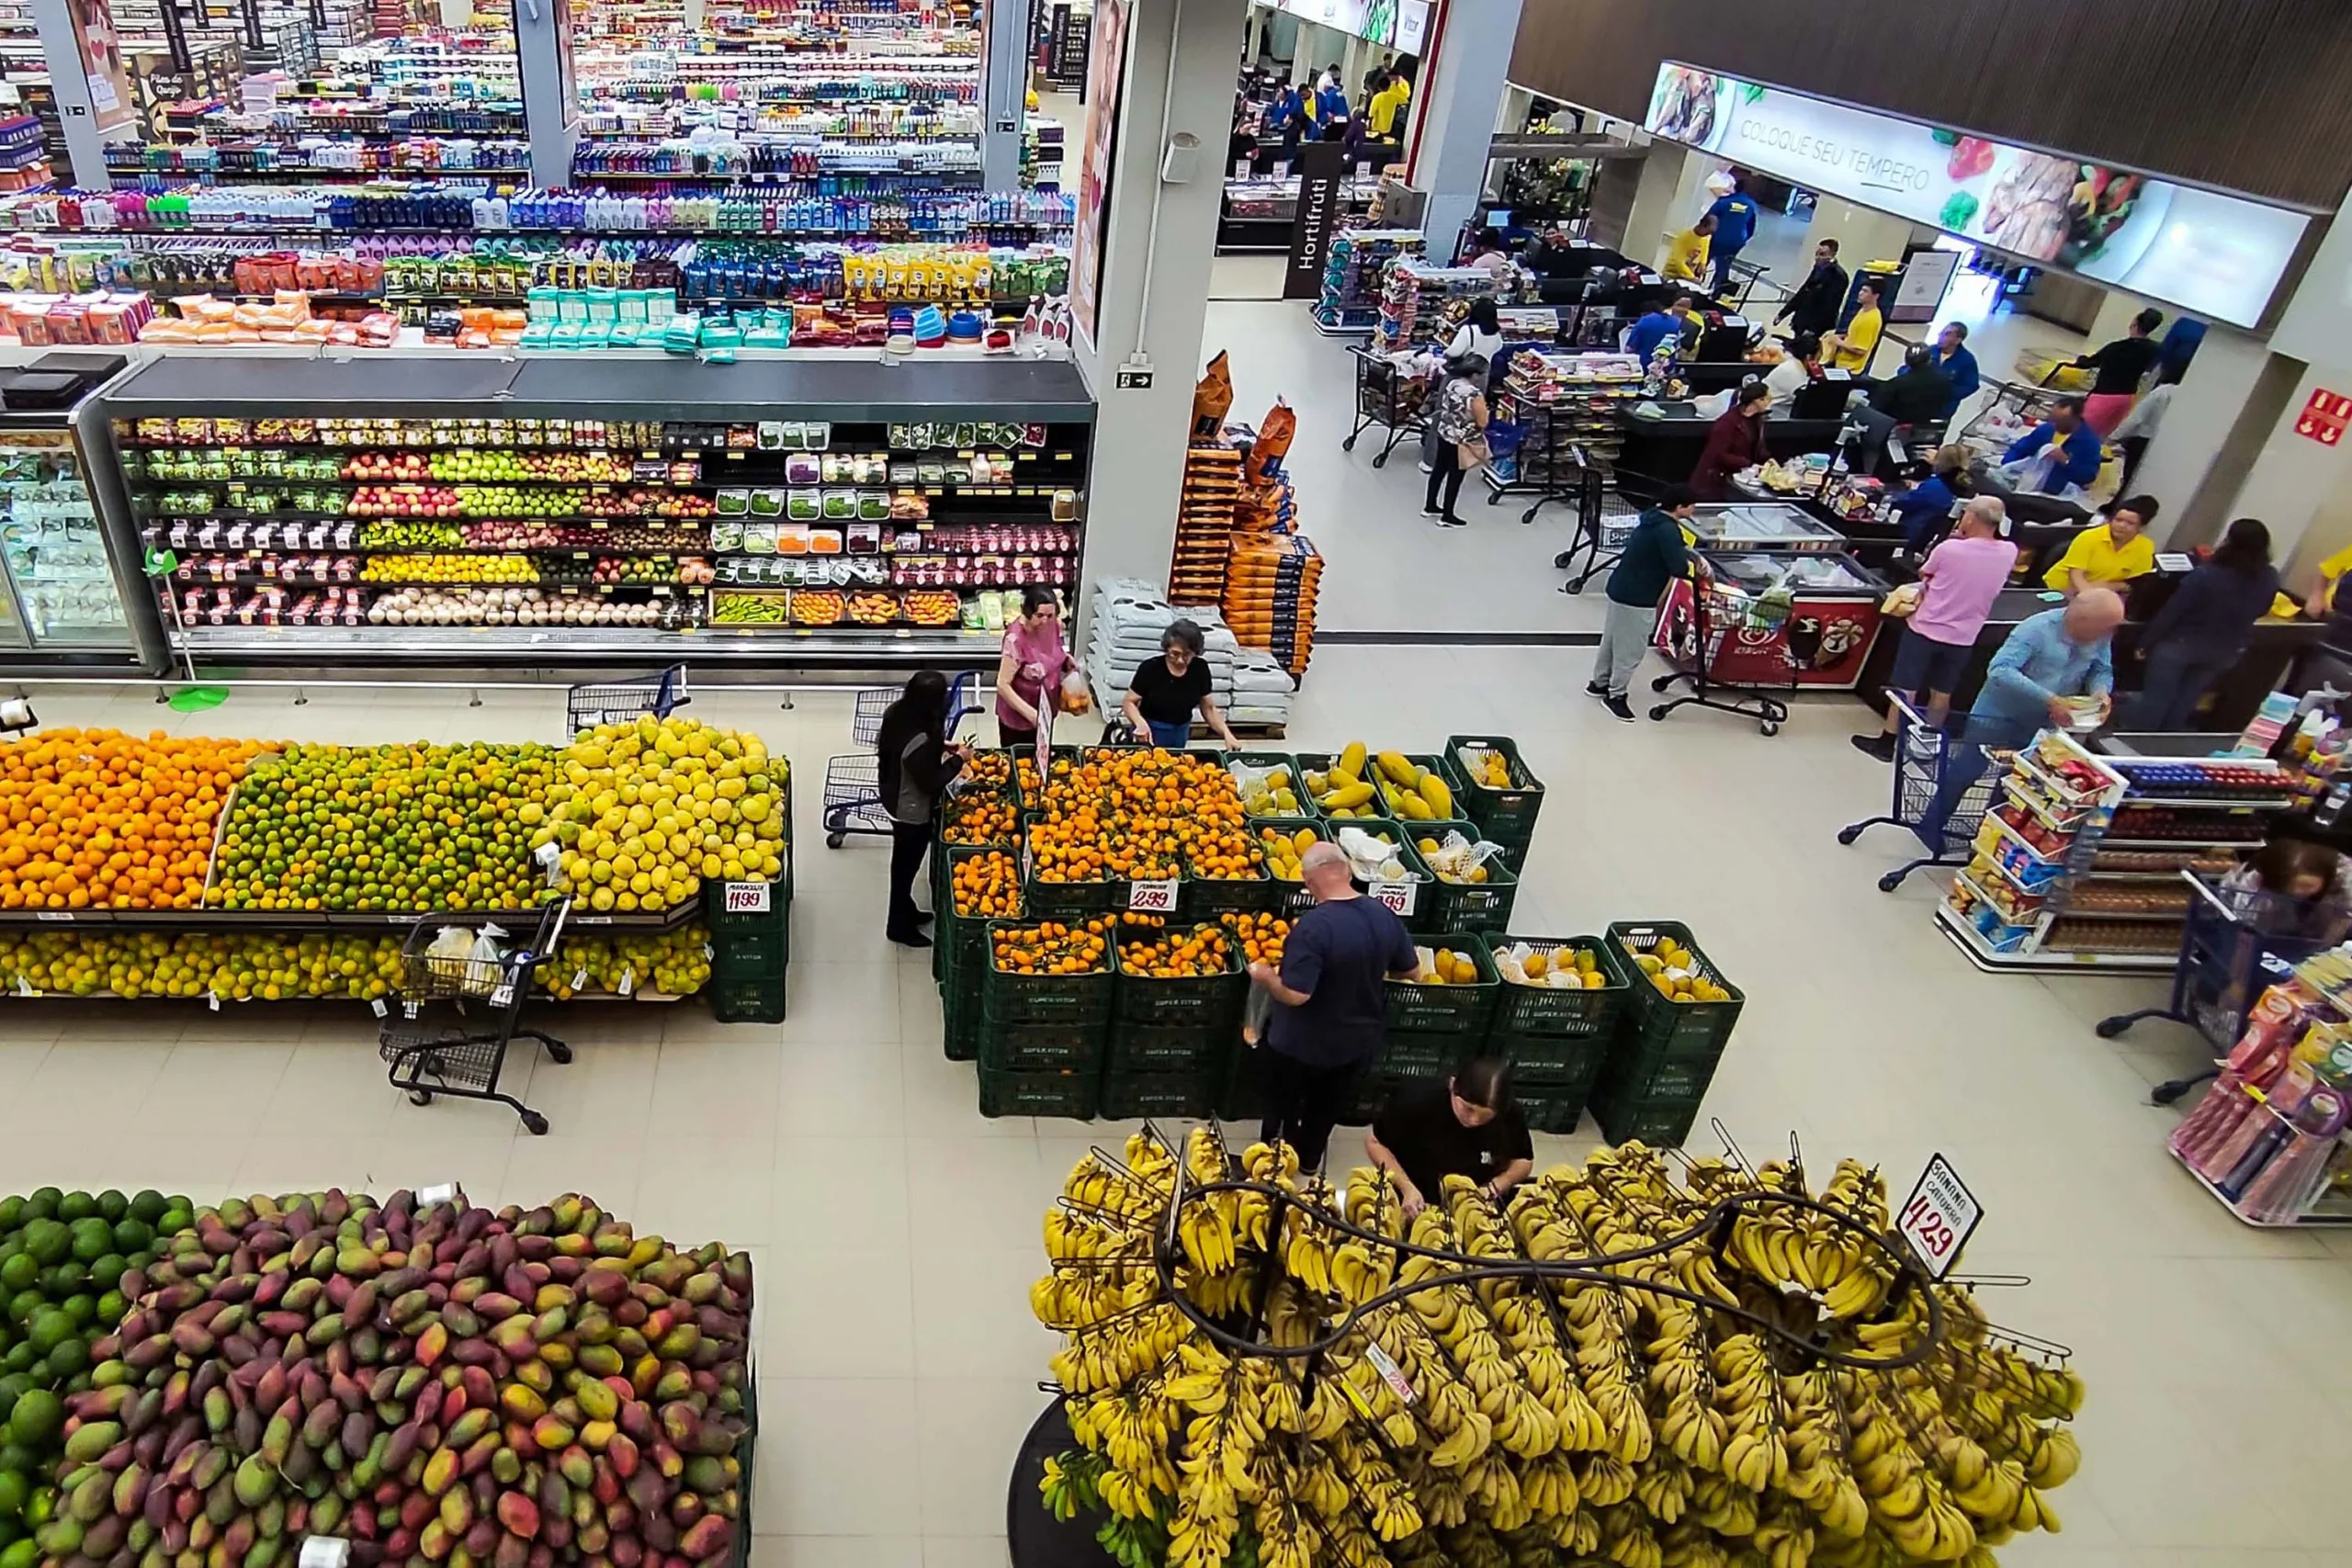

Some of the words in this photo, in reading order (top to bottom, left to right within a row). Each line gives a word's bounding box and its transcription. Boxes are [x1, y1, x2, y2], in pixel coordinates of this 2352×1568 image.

[1056, 12, 1066, 42] Infantis
[1053, 44, 1063, 74] Artigos
[1740, 119, 1812, 156] COLOQUE
[1812, 139, 1845, 165] SEU
[1849, 149, 1930, 191] TEMPERO
[1298, 178, 1329, 269] Hortifrúti
[1926, 1179, 1962, 1228] CATURRA
[1930, 1162, 1967, 1211] BANANA
